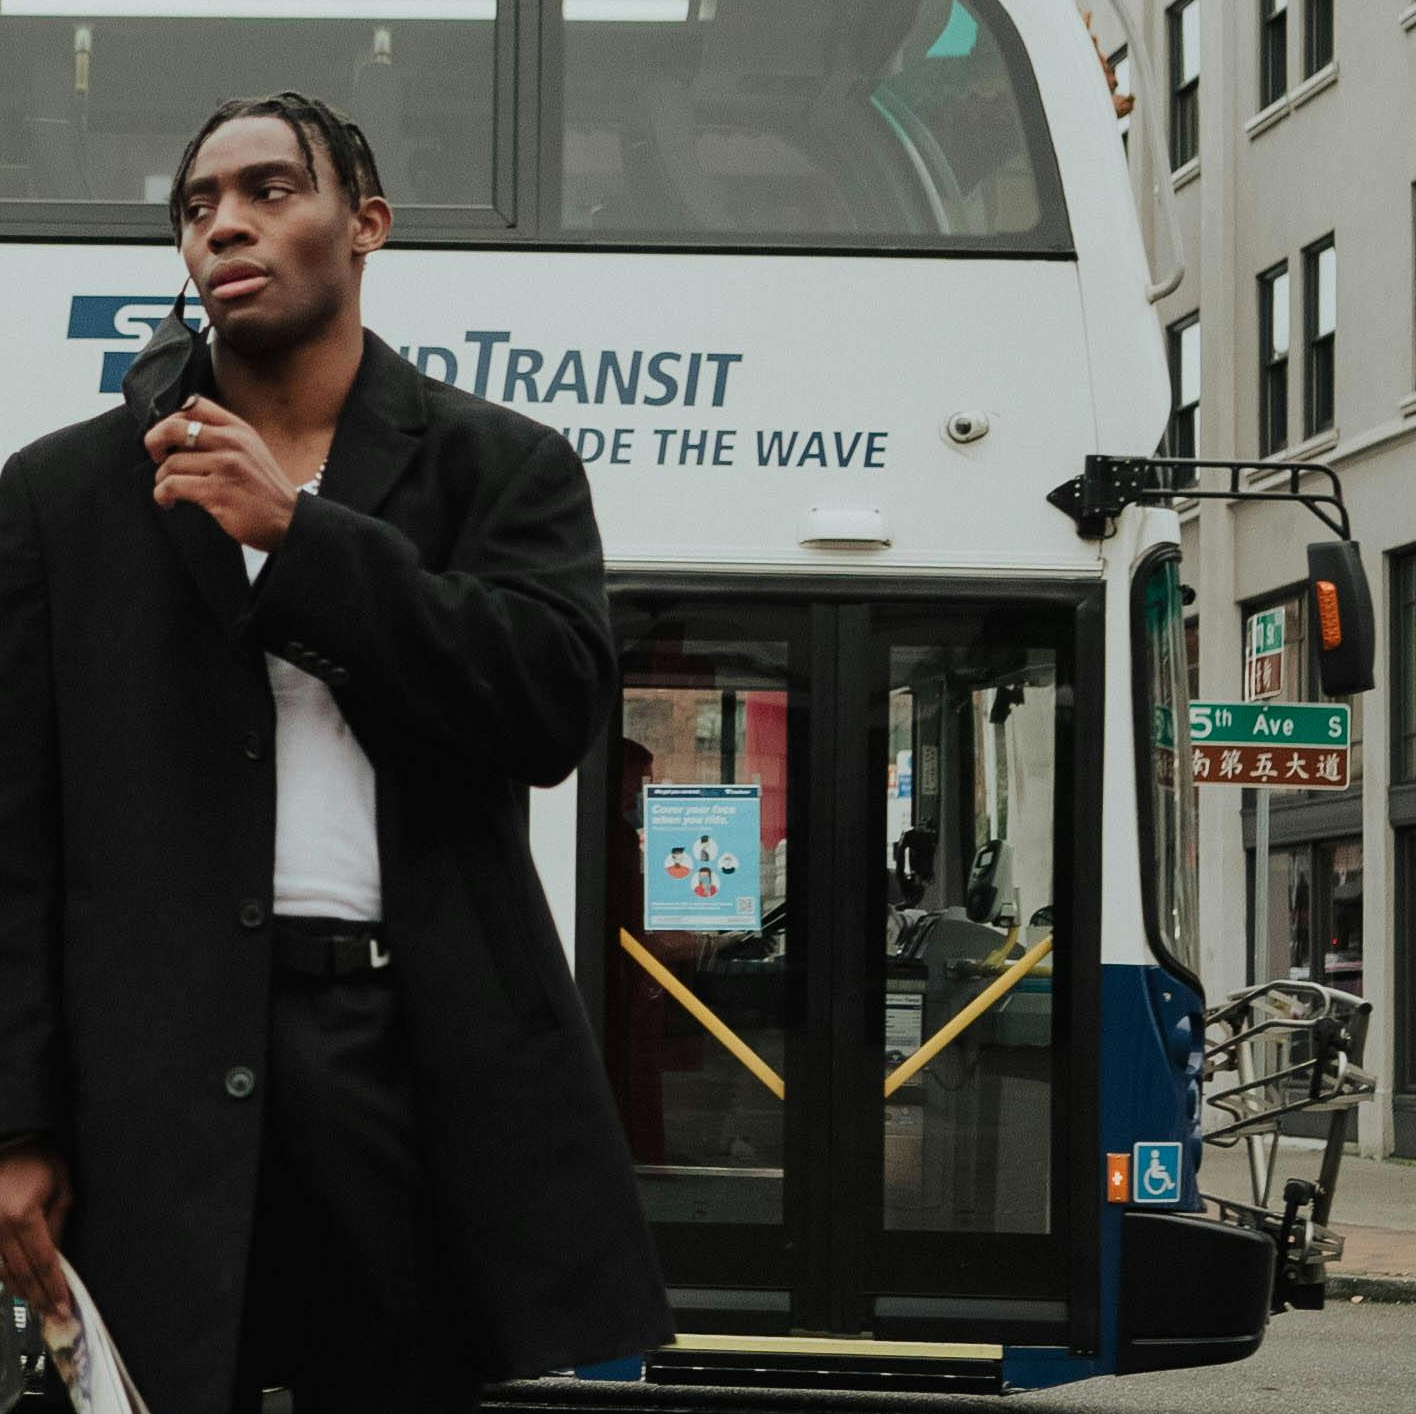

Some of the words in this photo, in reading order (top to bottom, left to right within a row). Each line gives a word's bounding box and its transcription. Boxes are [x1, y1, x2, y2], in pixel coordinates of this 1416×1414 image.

[400, 330, 742, 408] DTRANSIT
[562, 427, 635, 465] DE
[653, 428, 737, 466] THE
[756, 430, 888, 468] WAVE
[1190, 706, 1233, 738] 5th
[1252, 713, 1294, 737] Ave
[1328, 715, 1343, 738] S
